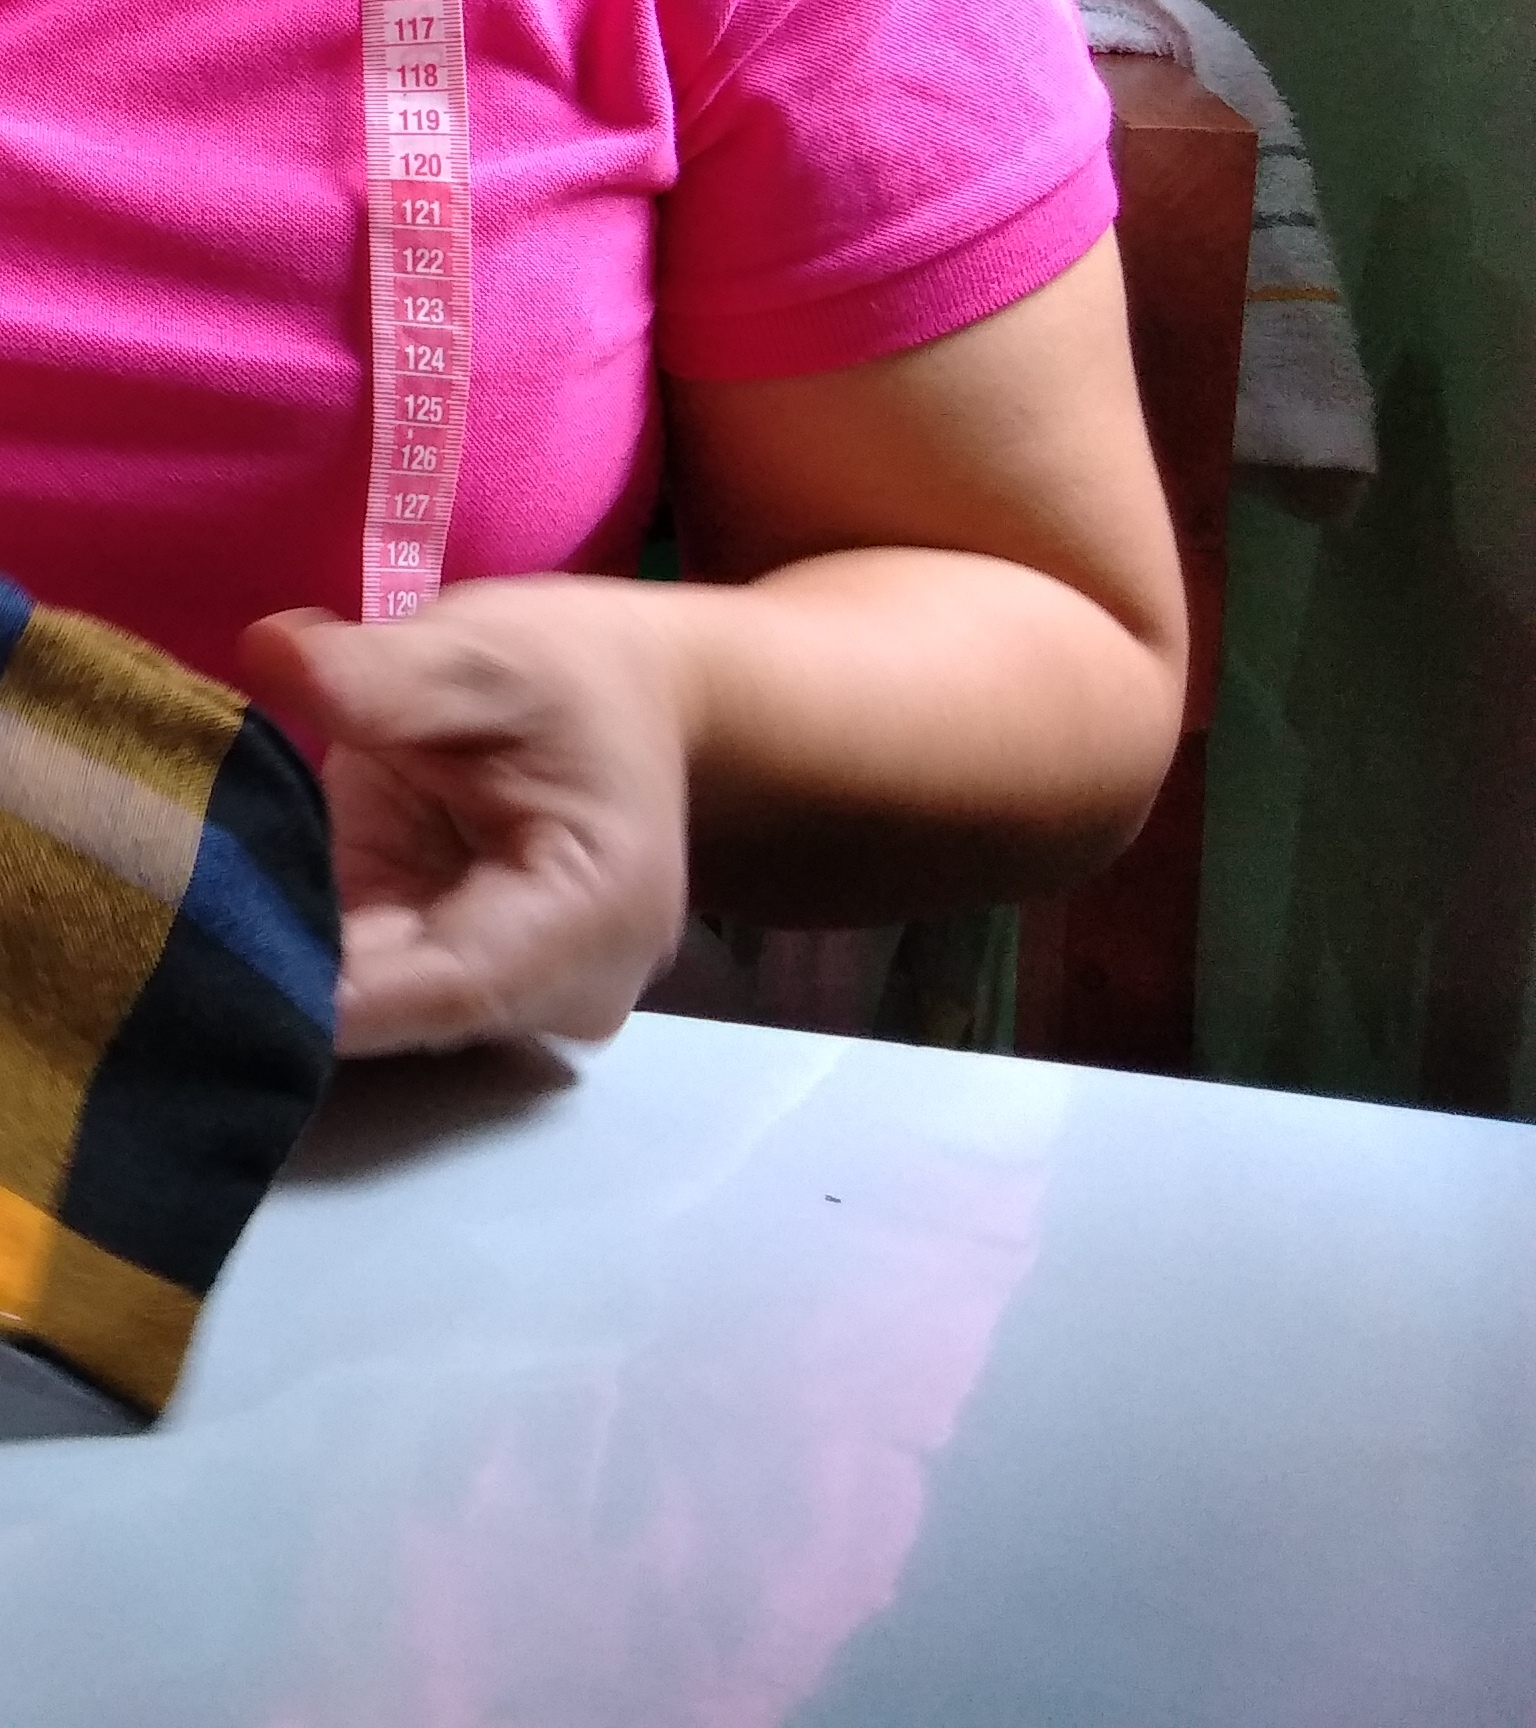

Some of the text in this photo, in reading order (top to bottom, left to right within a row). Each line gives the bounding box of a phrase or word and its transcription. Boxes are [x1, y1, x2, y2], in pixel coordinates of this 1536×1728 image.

[394, 16, 435, 41] 117
[396, 64, 437, 87] 118
[399, 109, 440, 131] 119
[400, 153, 442, 177] 120
[402, 199, 442, 225] 121
[402, 247, 444, 274] 122
[404, 296, 445, 324] 123
[405, 344, 445, 372] 124
[404, 394, 443, 422] 125
[401, 444, 437, 472] 126
[394, 494, 429, 519] 127
[387, 540, 420, 568] 128
[387, 591, 418, 617] 129
